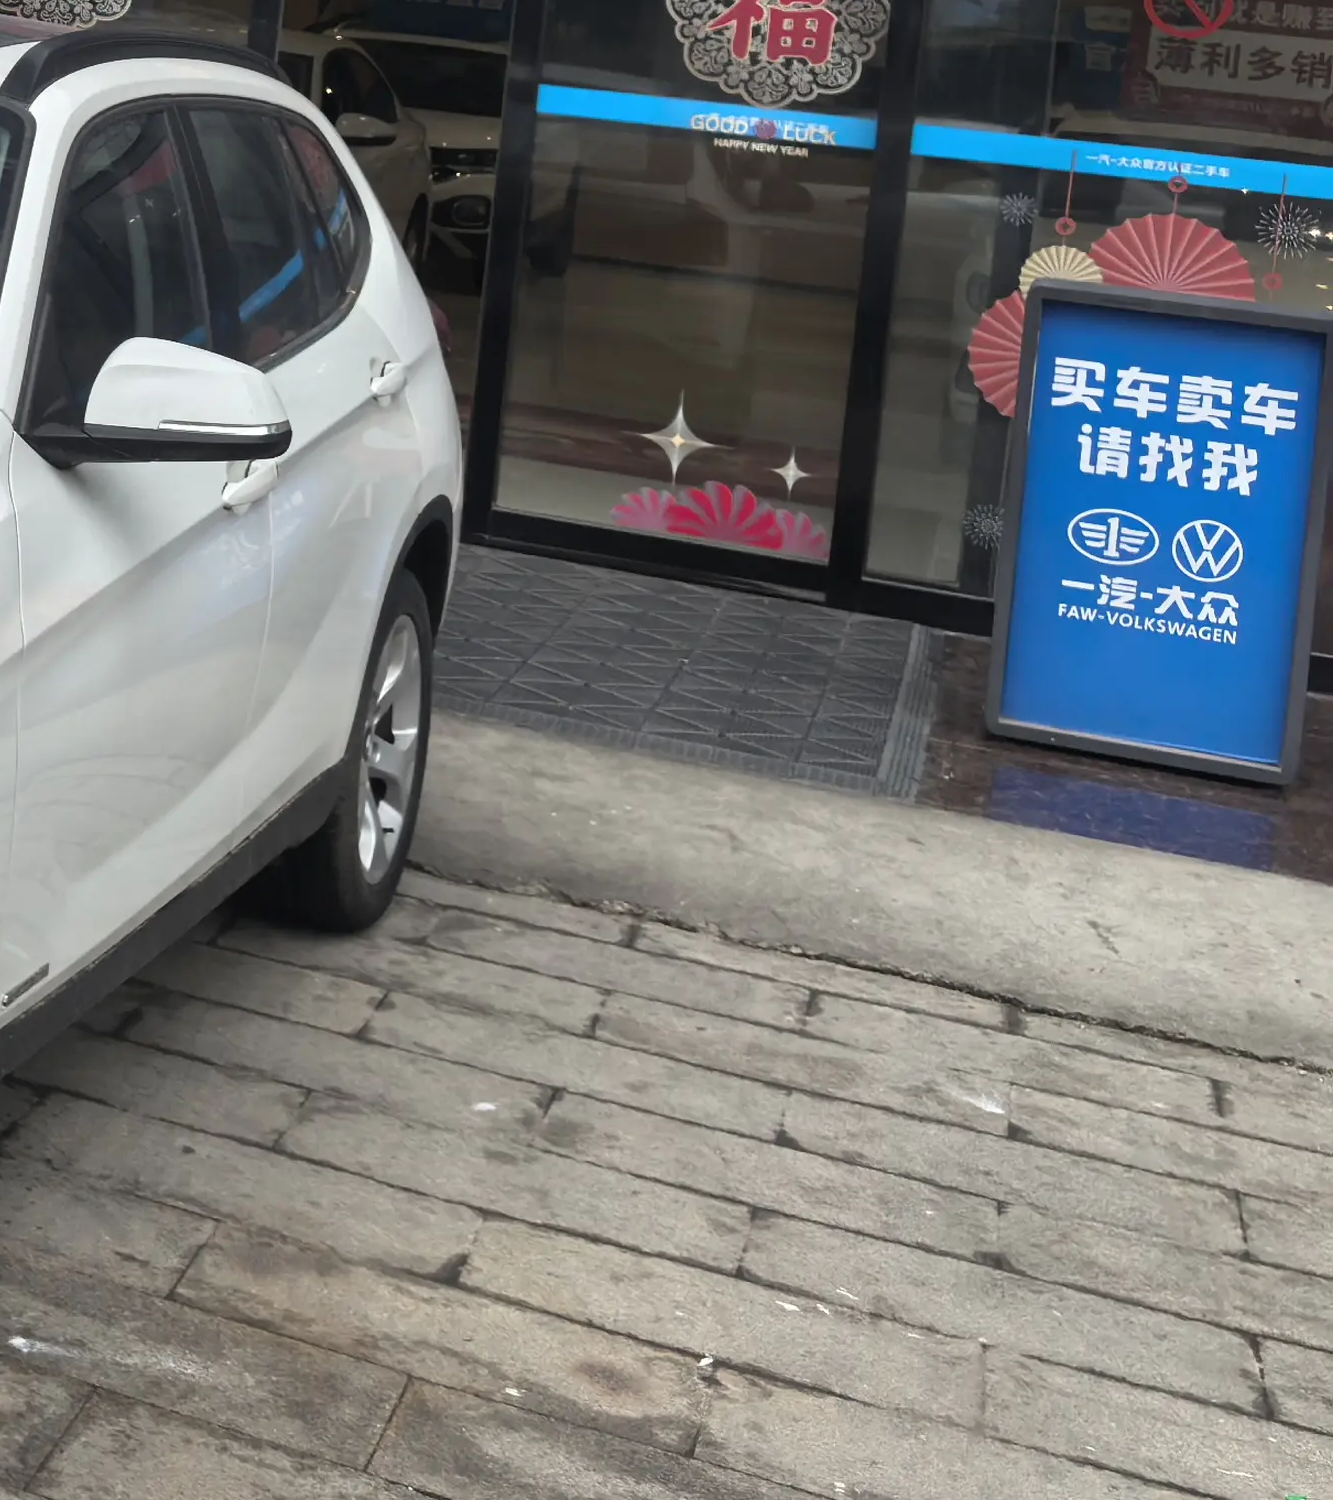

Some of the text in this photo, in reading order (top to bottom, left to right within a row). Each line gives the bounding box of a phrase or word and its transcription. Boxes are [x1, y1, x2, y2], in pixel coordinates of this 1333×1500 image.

[713, 137, 809, 158] HAPPY NEW YEAR
[1085, 154, 1231, 179] 一汽-大众官方认证二手车
[1050, 356, 1299, 436] 买车卖车
[1077, 423, 1258, 497] 请找我
[1058, 602, 1238, 645] FAW-VOLKSWAGEN
[1061, 574, 1239, 626] 一汽-大众
